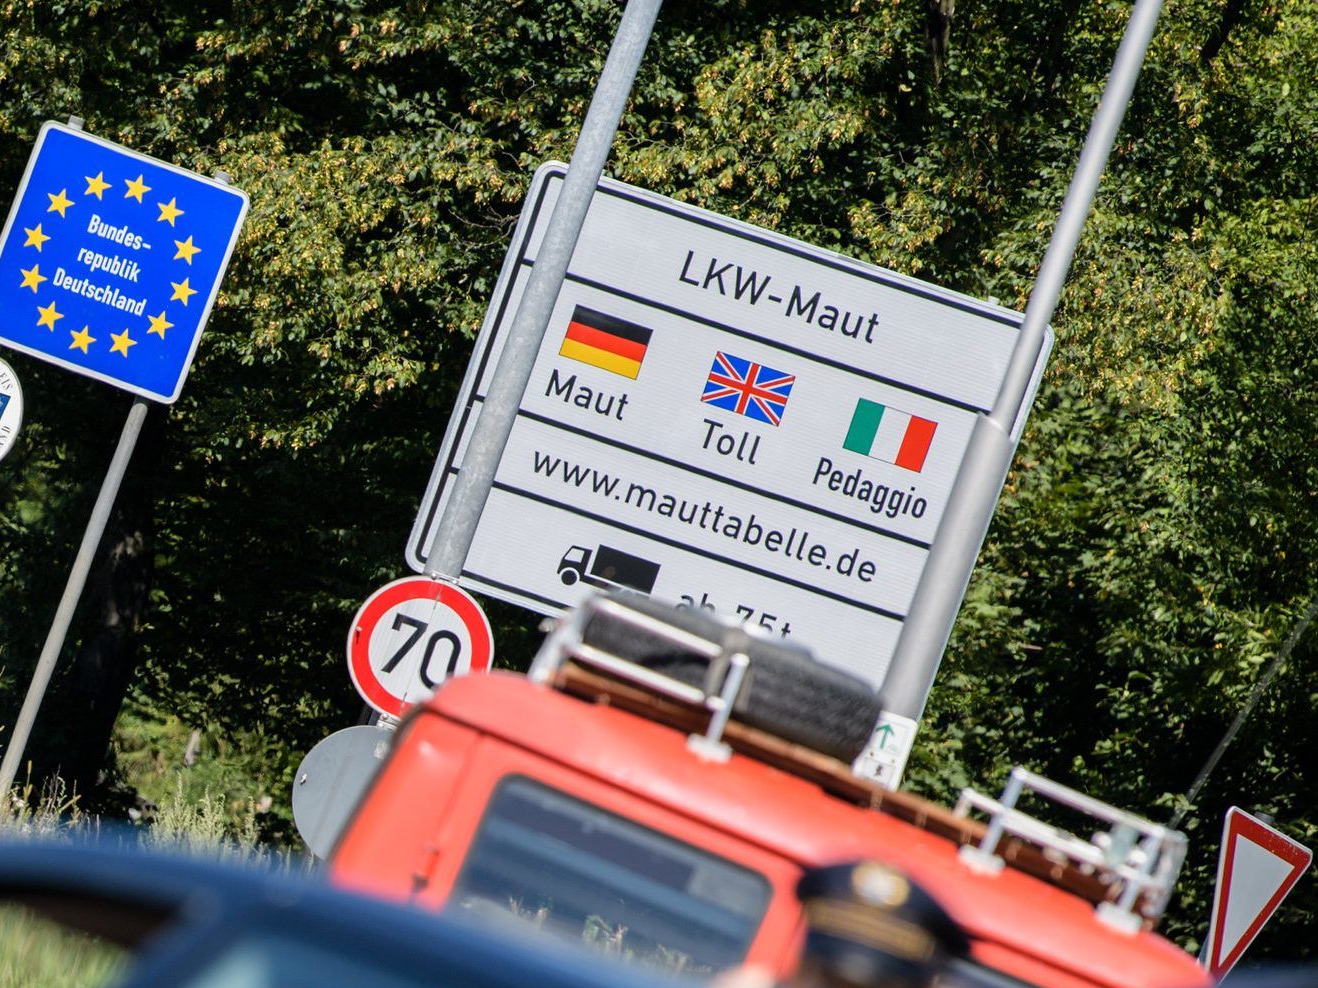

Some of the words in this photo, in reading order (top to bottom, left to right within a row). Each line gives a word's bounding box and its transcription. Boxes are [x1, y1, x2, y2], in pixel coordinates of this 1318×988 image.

[87, 214, 151, 250] Bundes-
[77, 247, 141, 282] republik
[52, 267, 147, 316] Deutschland
[679, 250, 879, 344] LKW-Maut
[545, 369, 628, 421] Maut
[702, 418, 761, 465] Toll
[812, 456, 927, 518] Pedaggio
[533, 451, 877, 582] www.mauttabelle.de
[380, 613, 461, 690] 70
